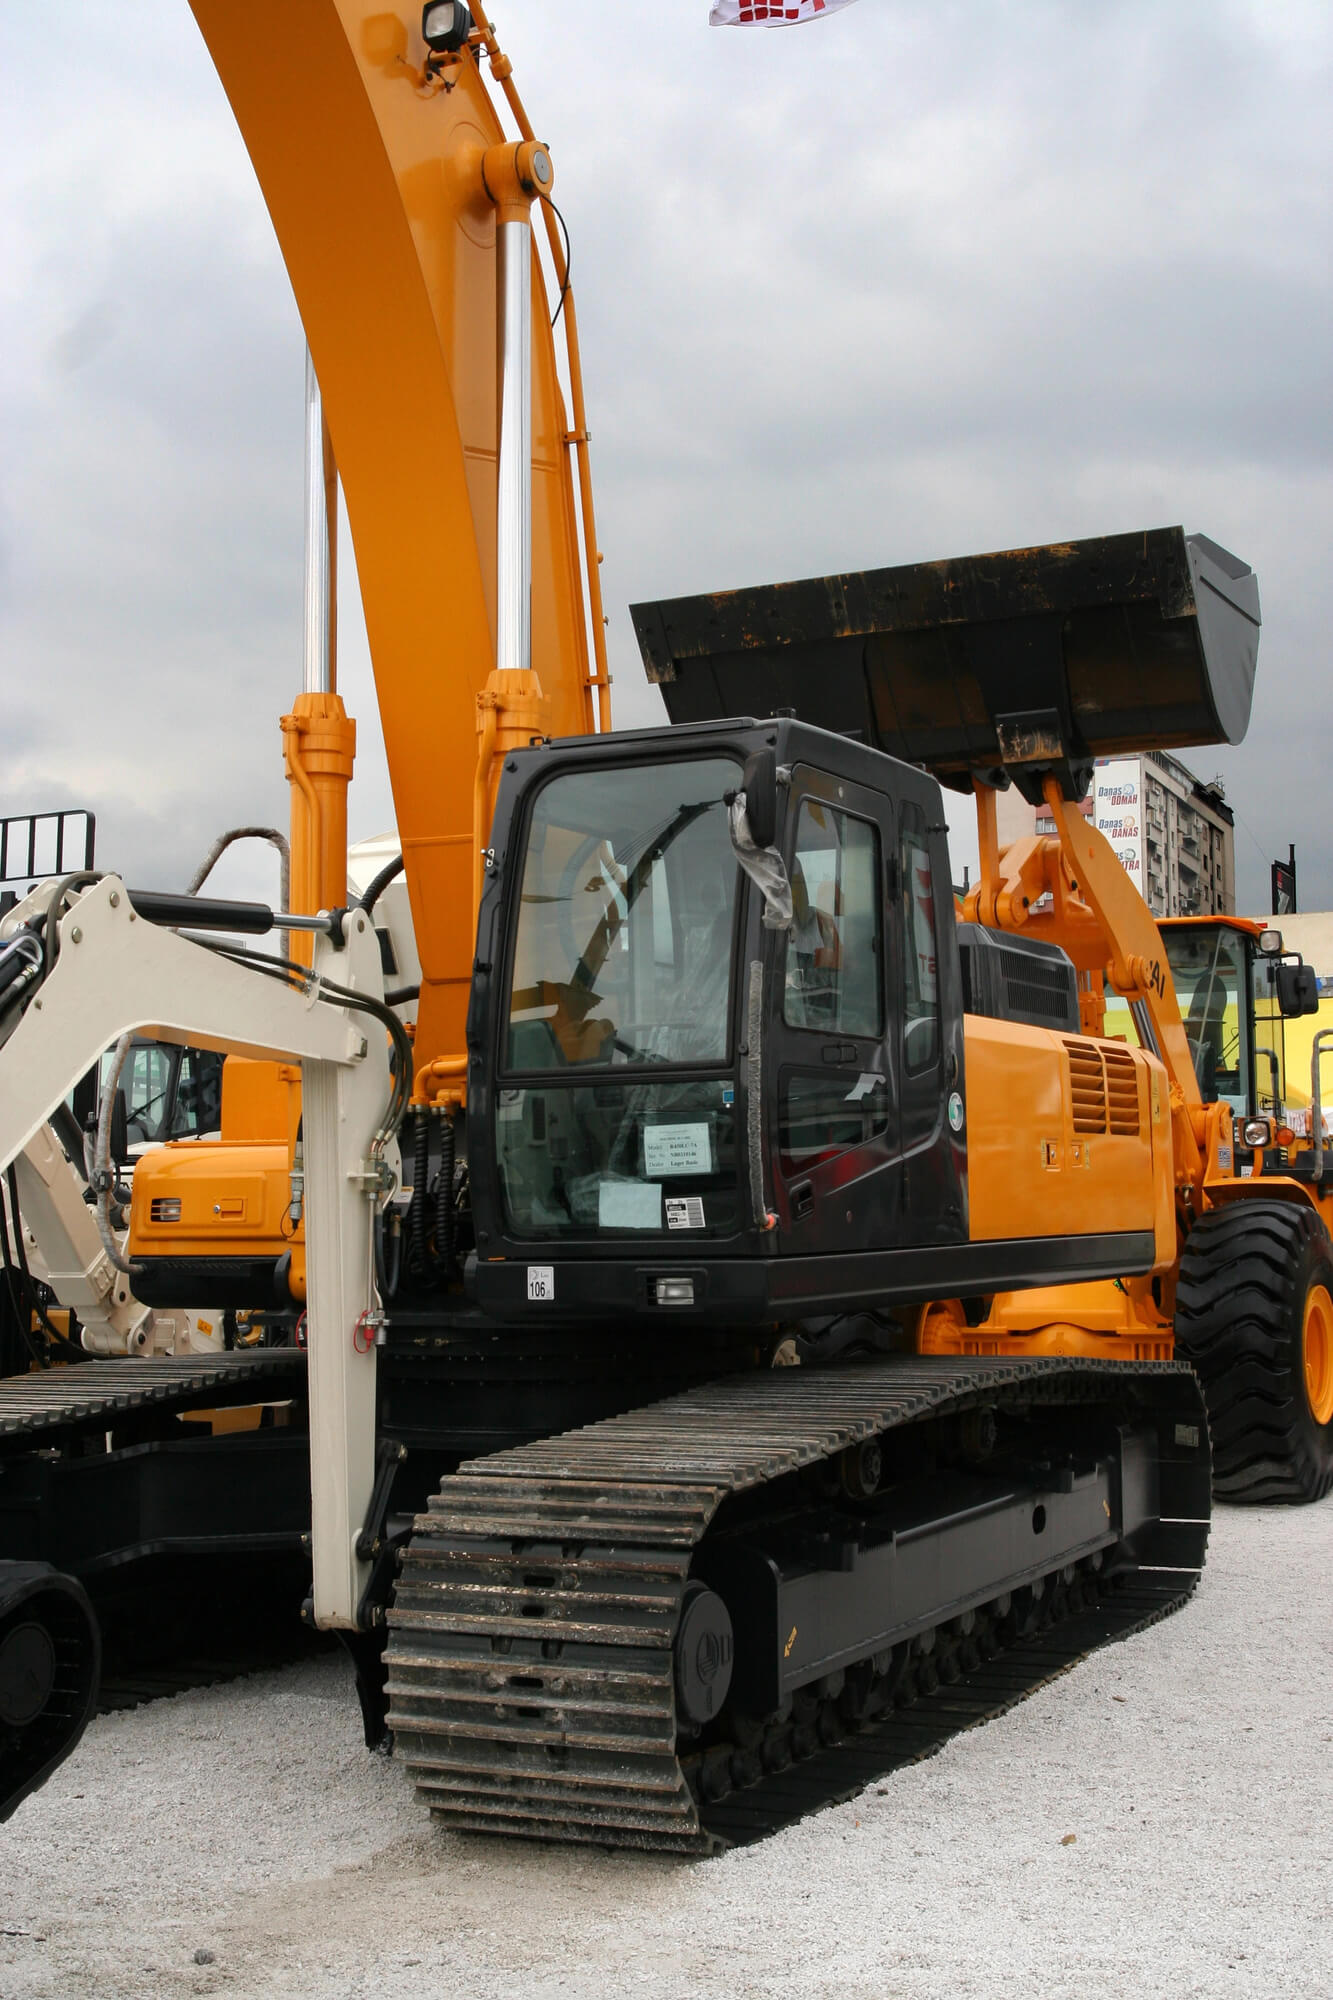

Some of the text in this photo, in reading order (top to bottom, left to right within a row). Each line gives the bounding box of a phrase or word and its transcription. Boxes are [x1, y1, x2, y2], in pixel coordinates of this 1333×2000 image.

[1098, 787, 1122, 797] Danas
[1111, 795, 1138, 805] ODMAH
[1099, 819, 1123, 829] Danas
[1112, 827, 1139, 838] DANAS
[530, 1281, 546, 1297] 106
